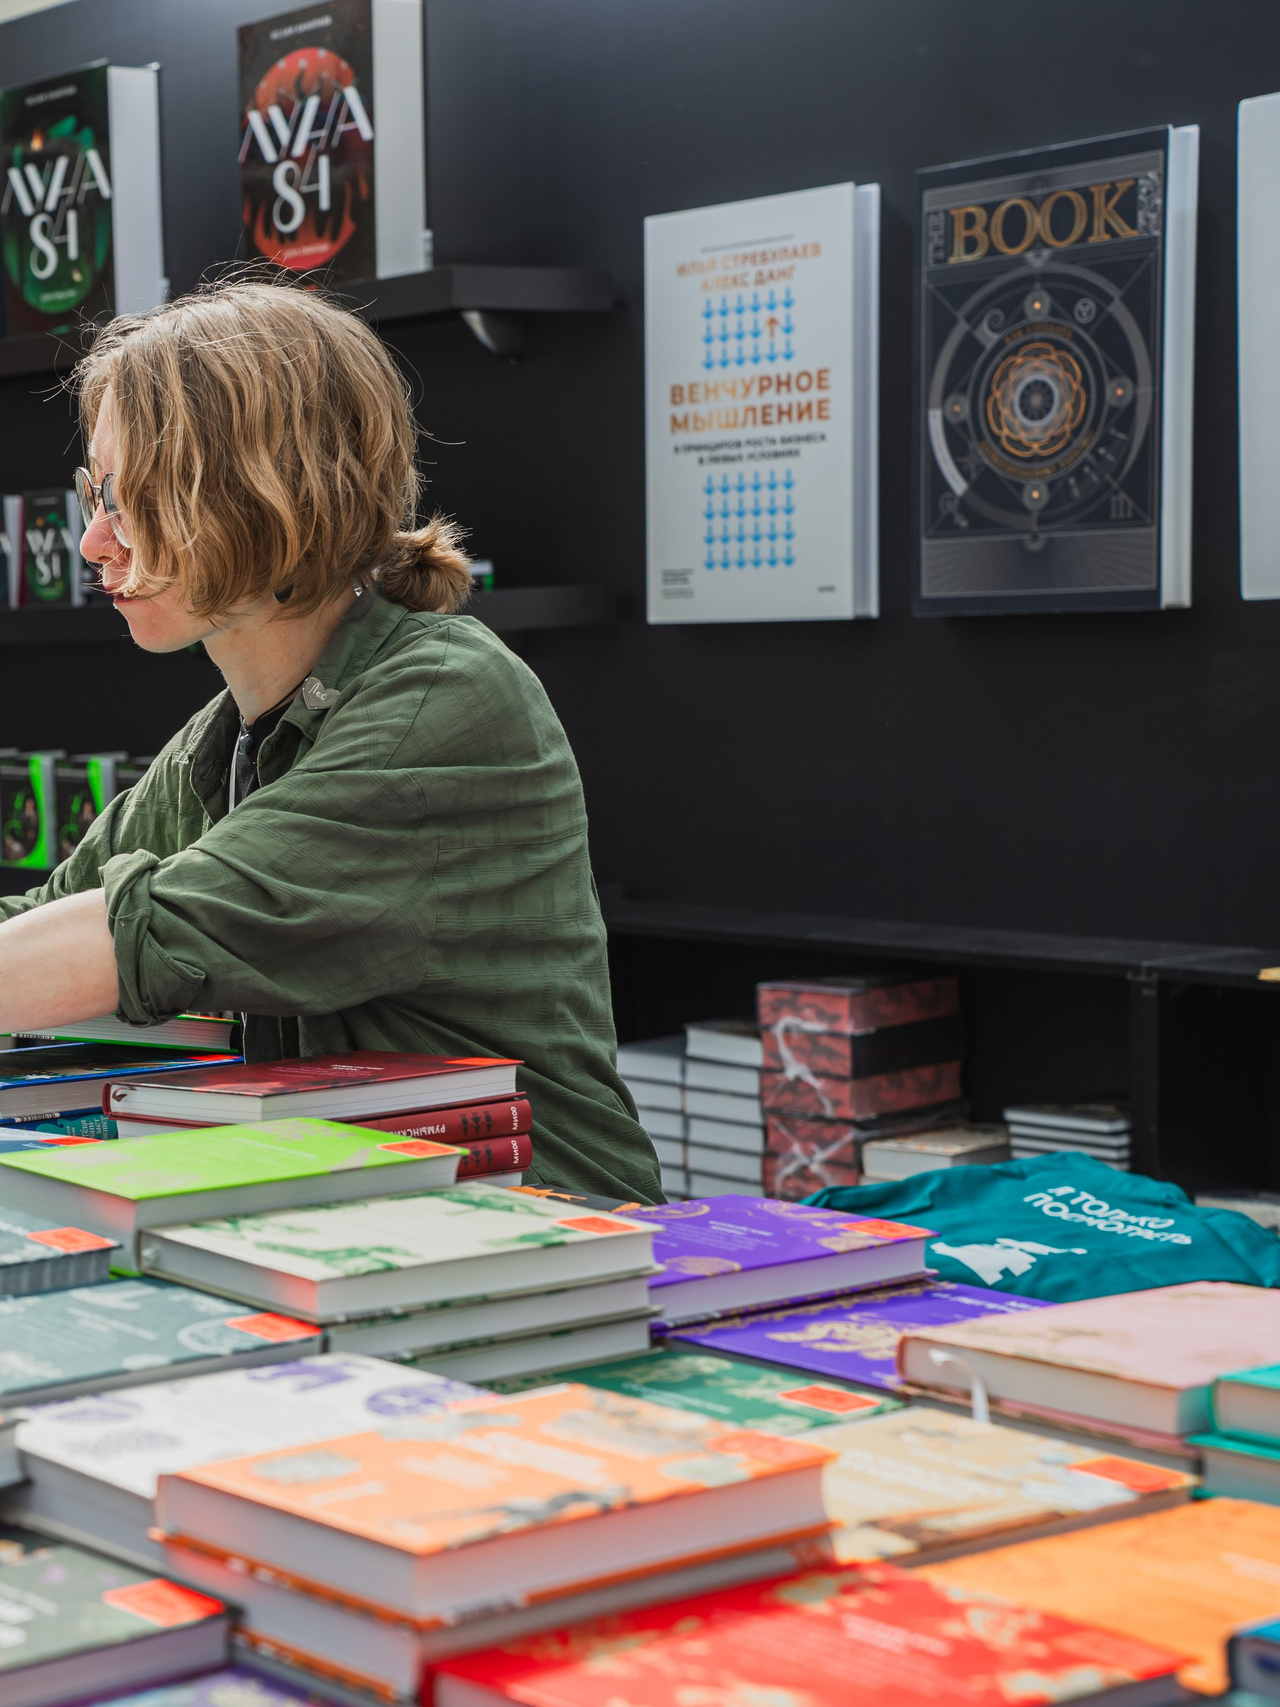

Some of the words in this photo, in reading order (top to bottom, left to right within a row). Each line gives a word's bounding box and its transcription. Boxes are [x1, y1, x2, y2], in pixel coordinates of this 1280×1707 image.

[947, 179, 1139, 264] BOOK
[669, 368, 831, 406] ВЕНЧУРНОЕ
[670, 399, 831, 435] МЫШЛЕНИЕ
[388, 1124, 446, 1138] РУМЫНСК
